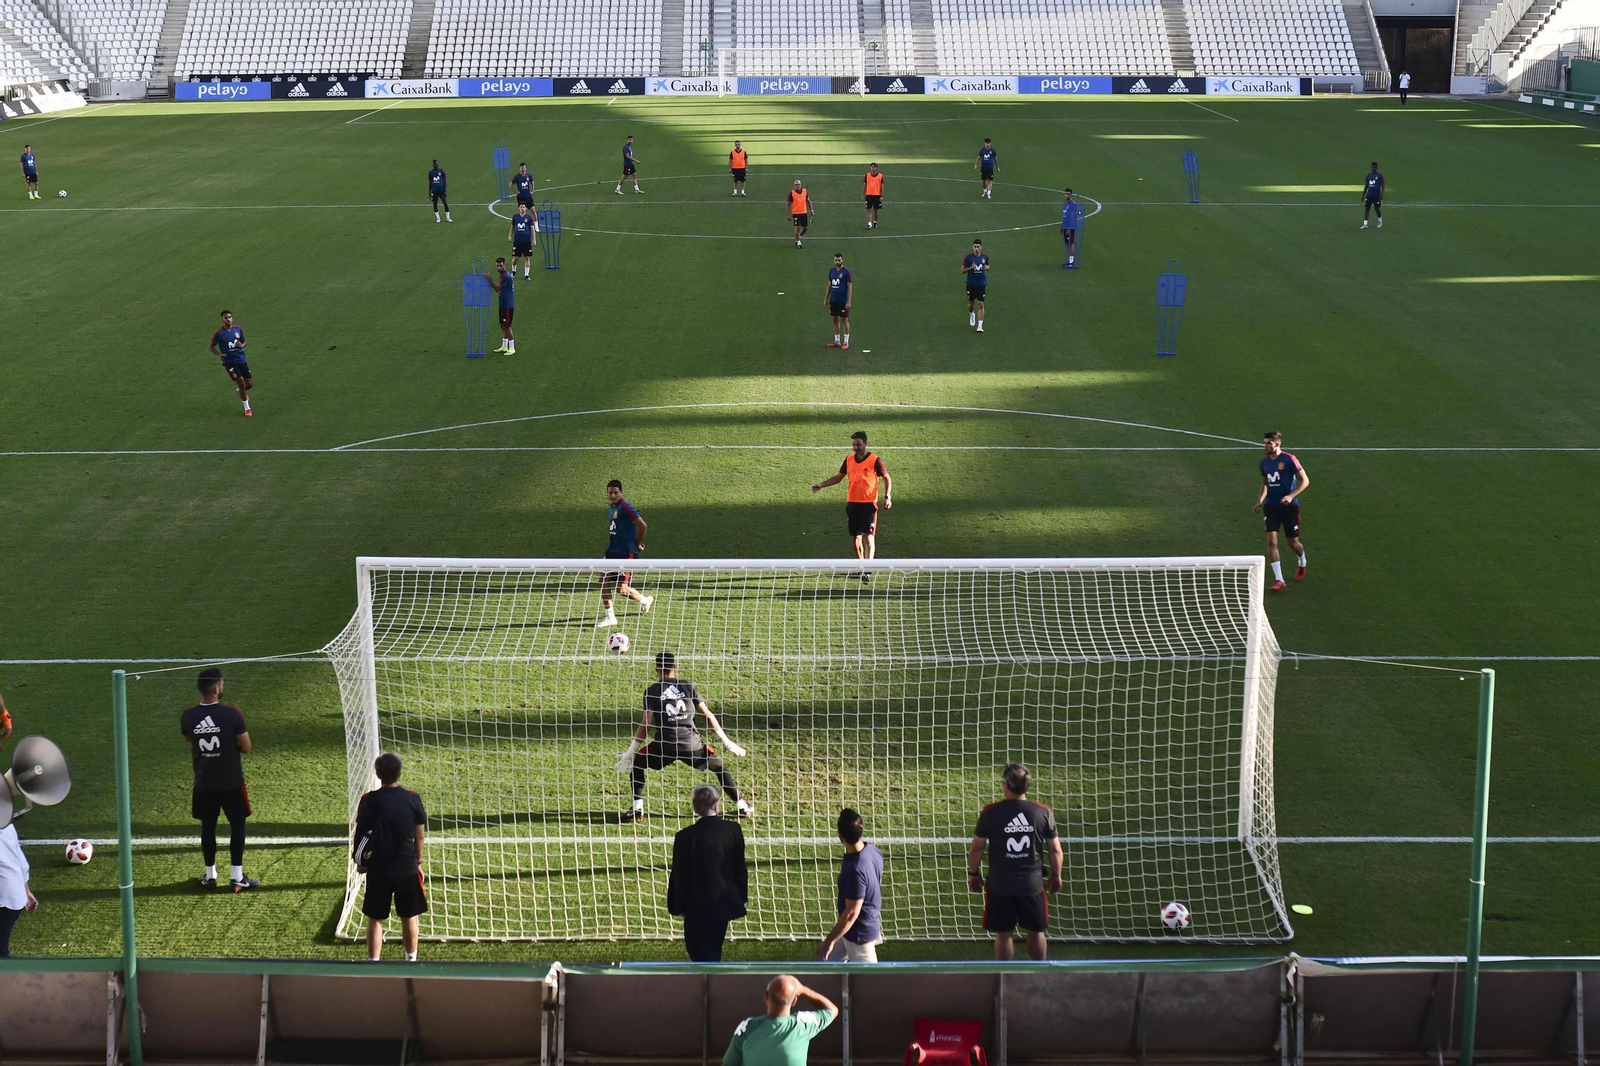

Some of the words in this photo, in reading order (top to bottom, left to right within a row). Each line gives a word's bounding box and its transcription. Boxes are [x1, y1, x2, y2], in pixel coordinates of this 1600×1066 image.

[198, 83, 248, 99] pelayo
[390, 82, 452, 95] CaixaBank
[481, 80, 531, 95] pelayo
[760, 78, 809, 93] pelayo
[950, 78, 1012, 92] CaixaBank
[1040, 77, 1090, 92] pelayo
[1231, 79, 1293, 92] CaixaBank
[193, 726, 221, 735] adidas
[1004, 825, 1034, 833] adidas
